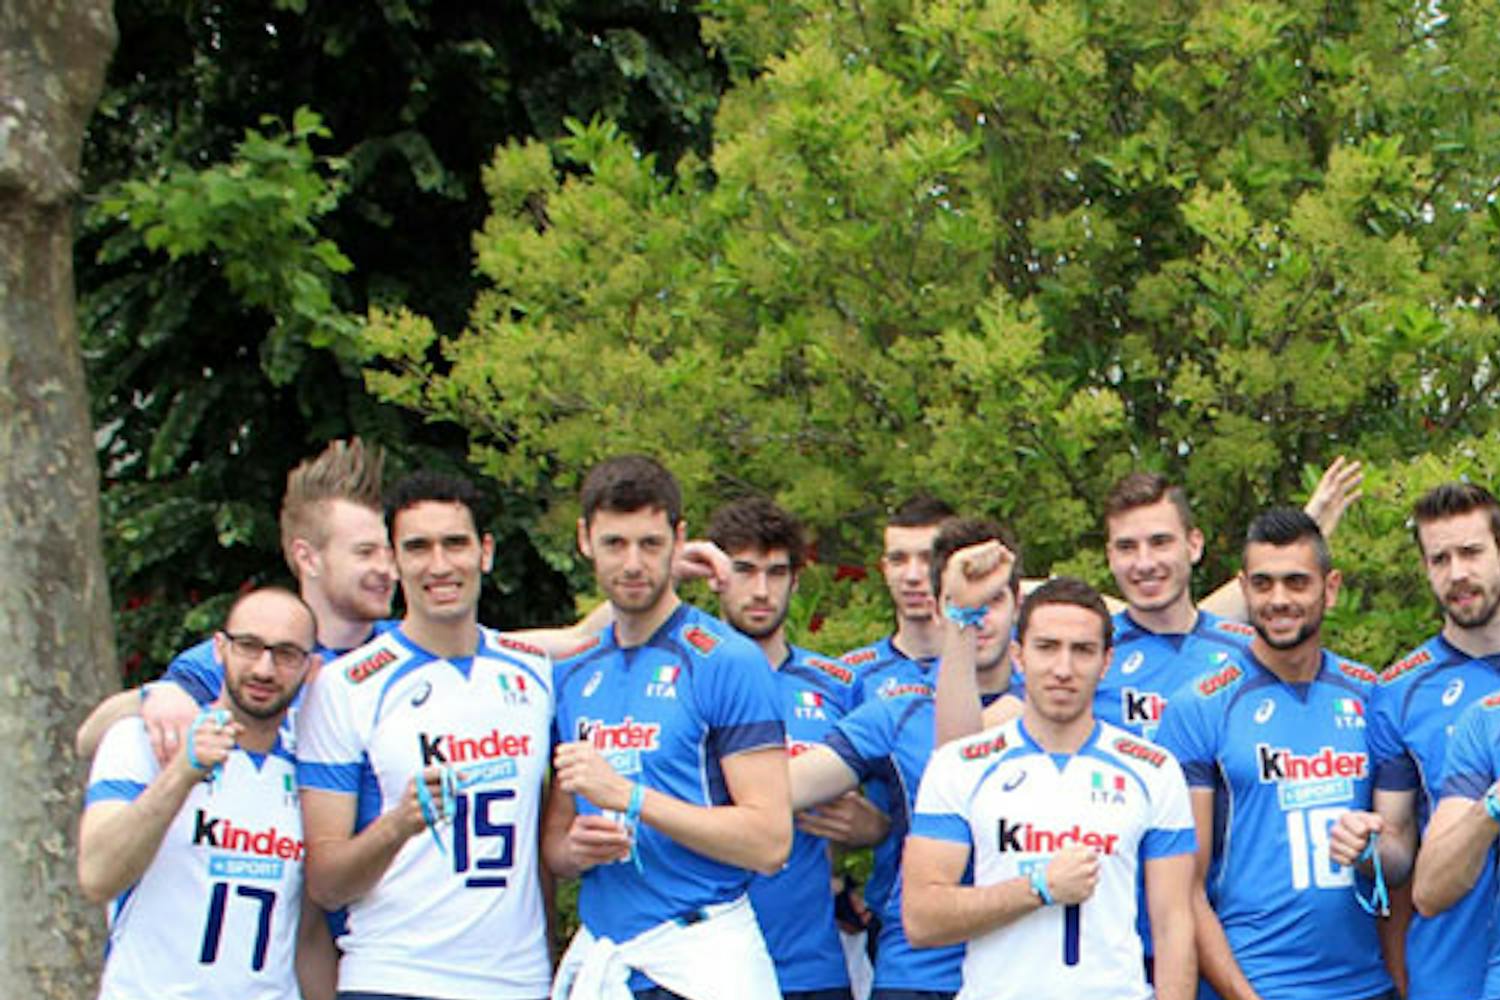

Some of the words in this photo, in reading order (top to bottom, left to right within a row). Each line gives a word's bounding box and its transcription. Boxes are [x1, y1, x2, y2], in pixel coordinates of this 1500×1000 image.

[647, 683, 677, 698] ITA
[794, 707, 828, 720] ITA
[1335, 714, 1366, 728] ITA
[418, 730, 530, 765] Kinder
[1261, 747, 1366, 781] Kinder
[1092, 791, 1126, 804] ITA
[193, 808, 304, 862] Kinder
[453, 789, 516, 873] 15
[198, 882, 276, 972] 17
